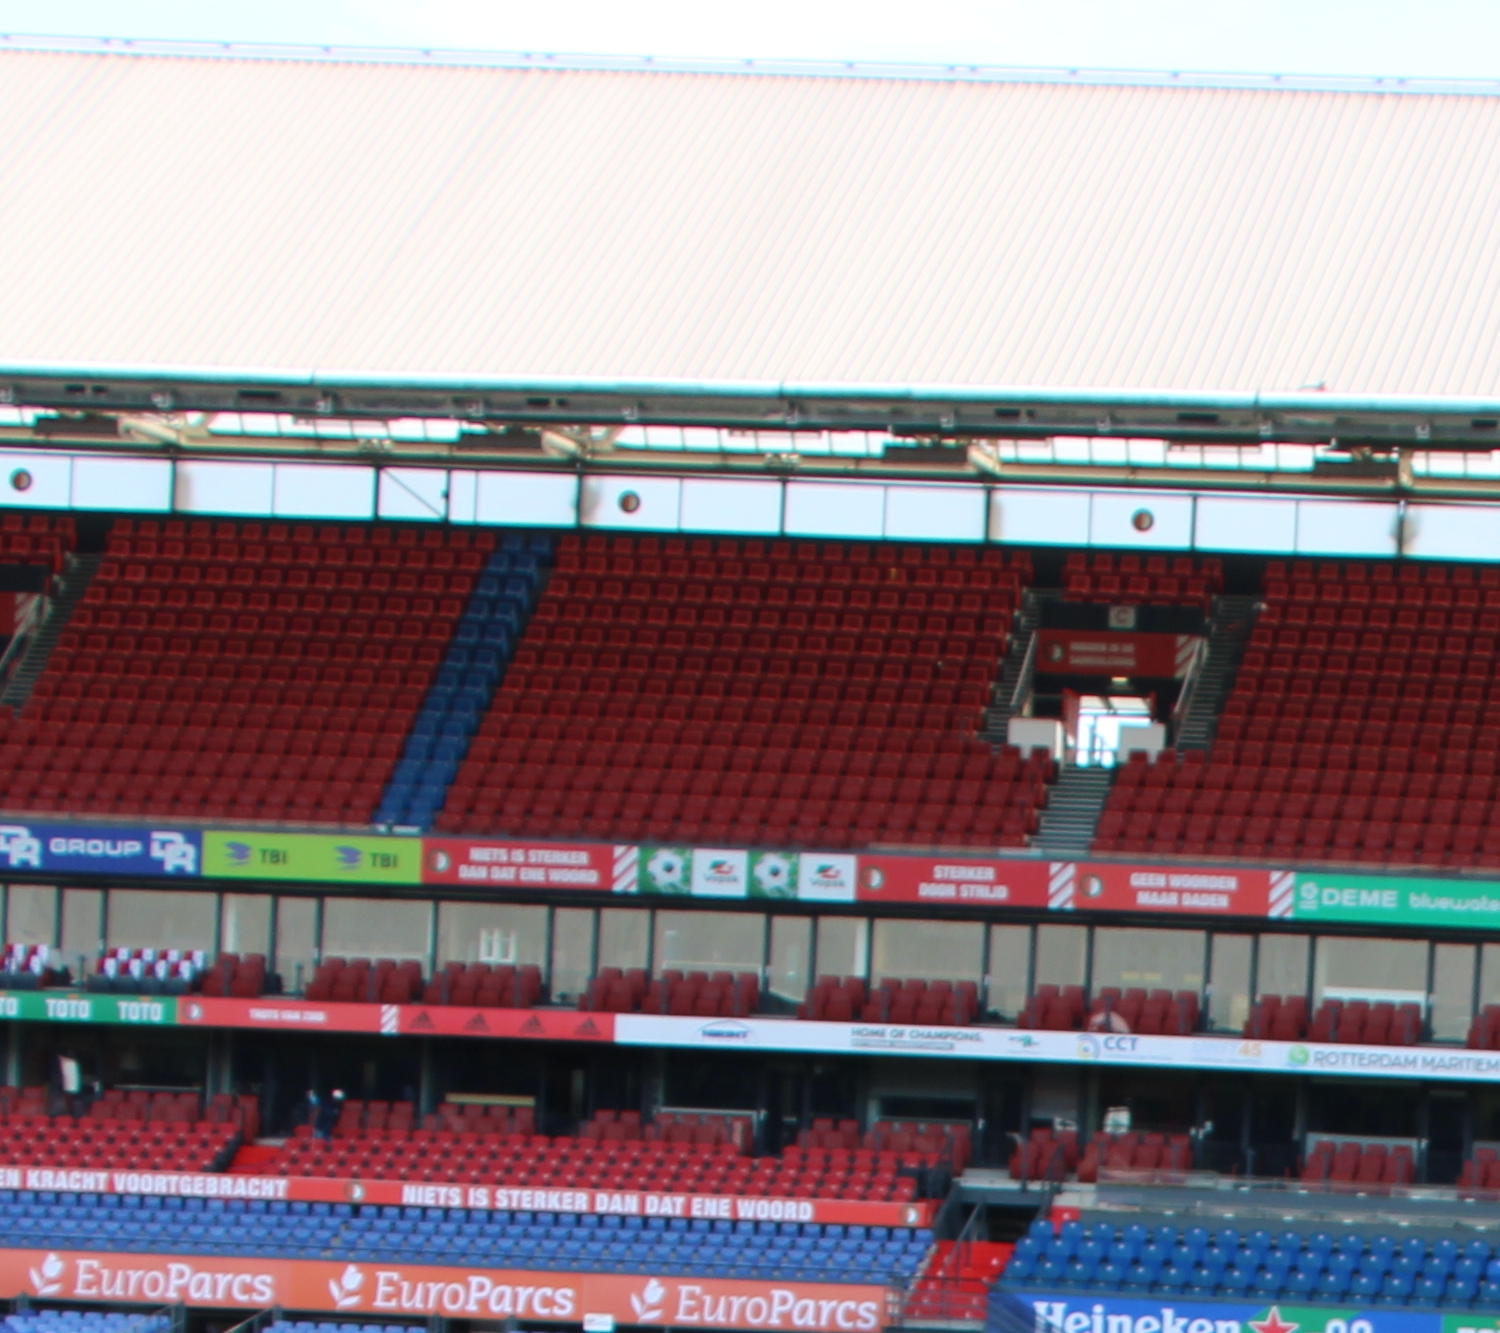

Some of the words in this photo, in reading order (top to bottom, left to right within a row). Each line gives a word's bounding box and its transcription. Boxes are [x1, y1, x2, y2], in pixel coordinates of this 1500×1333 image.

[49, 837, 143, 858] GROUP
[260, 848, 288, 865] TBI
[369, 852, 398, 869] TBI
[1321, 889, 1398, 909] DEME
[45, 998, 90, 1019] TOTO
[118, 1001, 163, 1021] TOTO
[851, 1027, 885, 1037] HOME
[889, 1028, 905, 1038] OF
[1103, 1036, 1140, 1051] CCT
[1313, 1051, 1419, 1069] ROTTERDAM
[25, 1169, 110, 1191] KRACHT
[113, 1173, 290, 1198] VOORTGEBRACHT
[401, 1184, 461, 1207] NIETS
[466, 1187, 489, 1208] IS
[493, 1188, 591, 1212] STERKER
[594, 1191, 639, 1213] DAN
[644, 1194, 687, 1216] DAT
[690, 1197, 732, 1218] ENE
[735, 1199, 815, 1223] WOORD
[75, 1259, 275, 1302] EuroParcs
[373, 1271, 575, 1317] EuroParcs
[675, 1285, 878, 1330] EuroParcs
